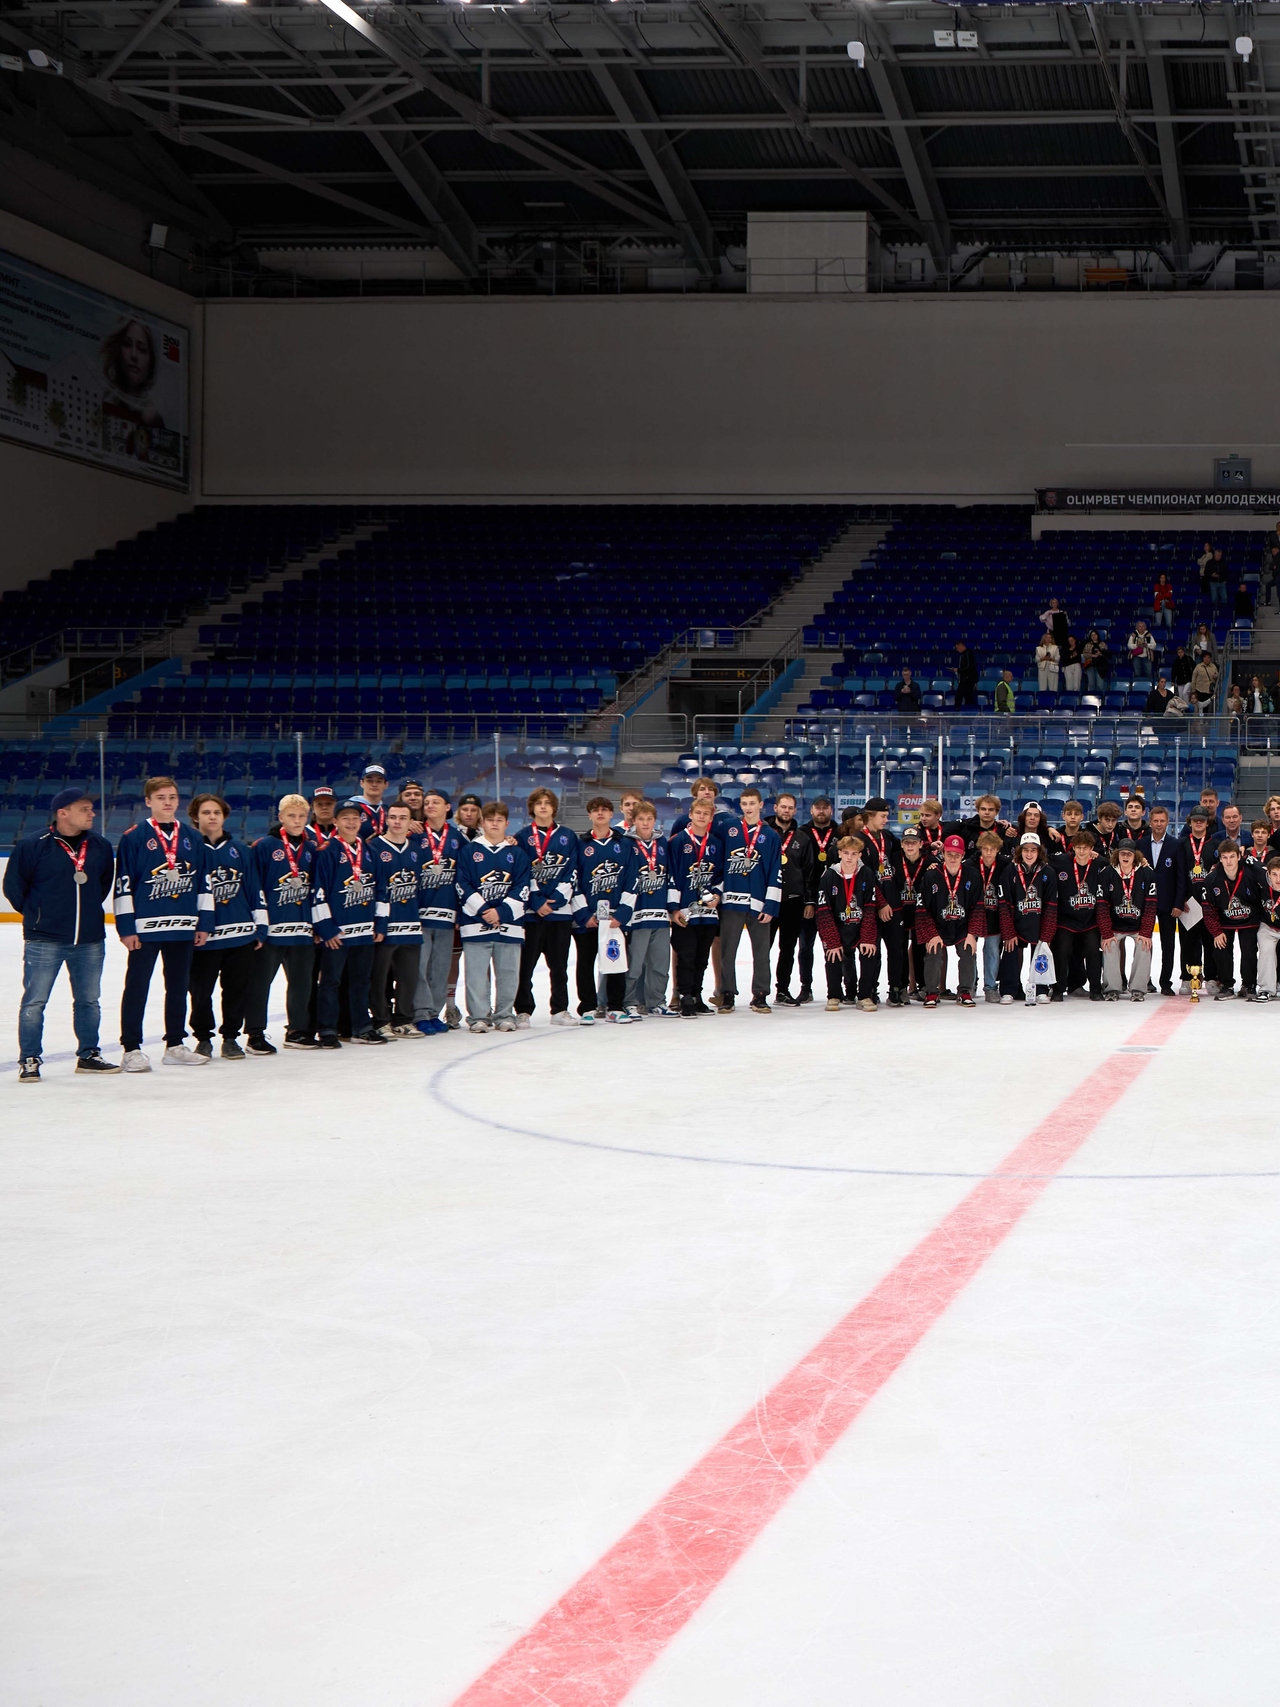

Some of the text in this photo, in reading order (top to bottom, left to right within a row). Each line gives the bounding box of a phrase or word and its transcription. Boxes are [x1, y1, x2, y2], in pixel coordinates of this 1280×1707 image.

[1066, 494, 1126, 505] OLIMPBET
[1128, 494, 1201, 505] ЧЕМПИОНАТ
[116, 876, 131, 894] 92
